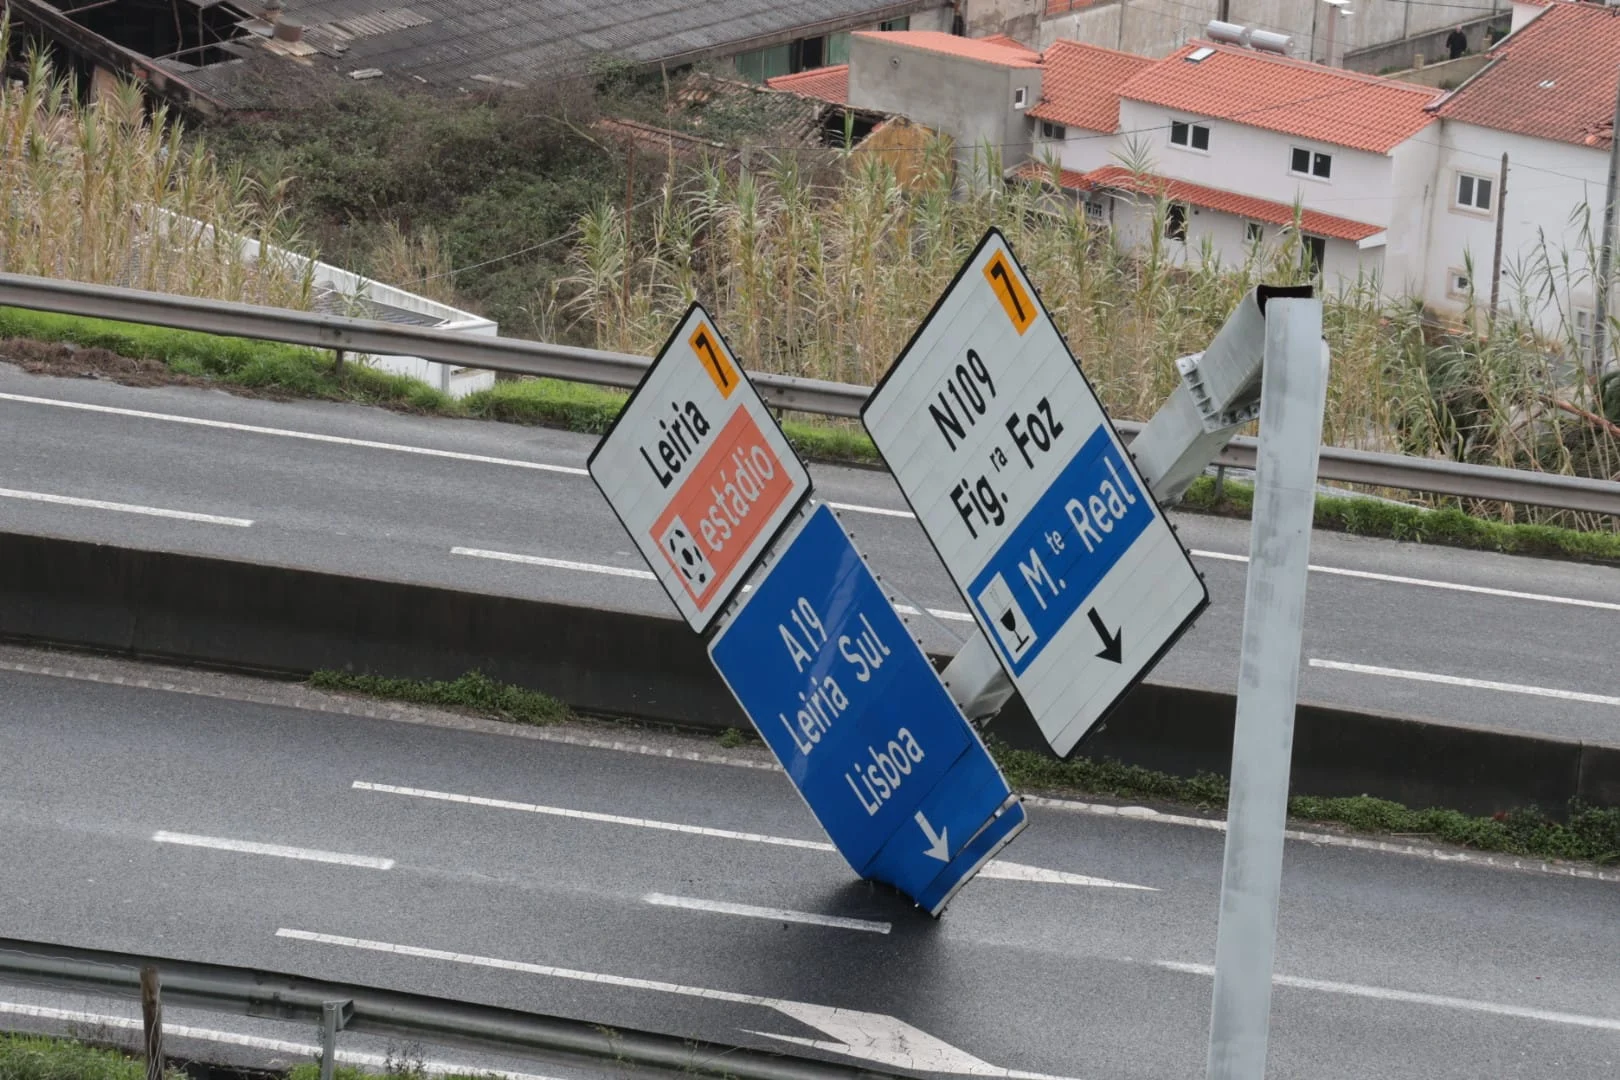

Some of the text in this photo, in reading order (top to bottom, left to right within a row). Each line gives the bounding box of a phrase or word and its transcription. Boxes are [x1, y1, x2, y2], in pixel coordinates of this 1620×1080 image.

[991, 260, 1026, 323] 7
[695, 332, 729, 389] 7
[928, 348, 997, 452] N109
[639, 400, 711, 489] Leiria
[1005, 396, 1064, 470] Foz
[699, 445, 775, 553] estádio
[1065, 455, 1136, 554] Real
[778, 597, 828, 673] A19
[779, 613, 891, 757] Leiria Sul
[845, 727, 925, 817] Lisboa
